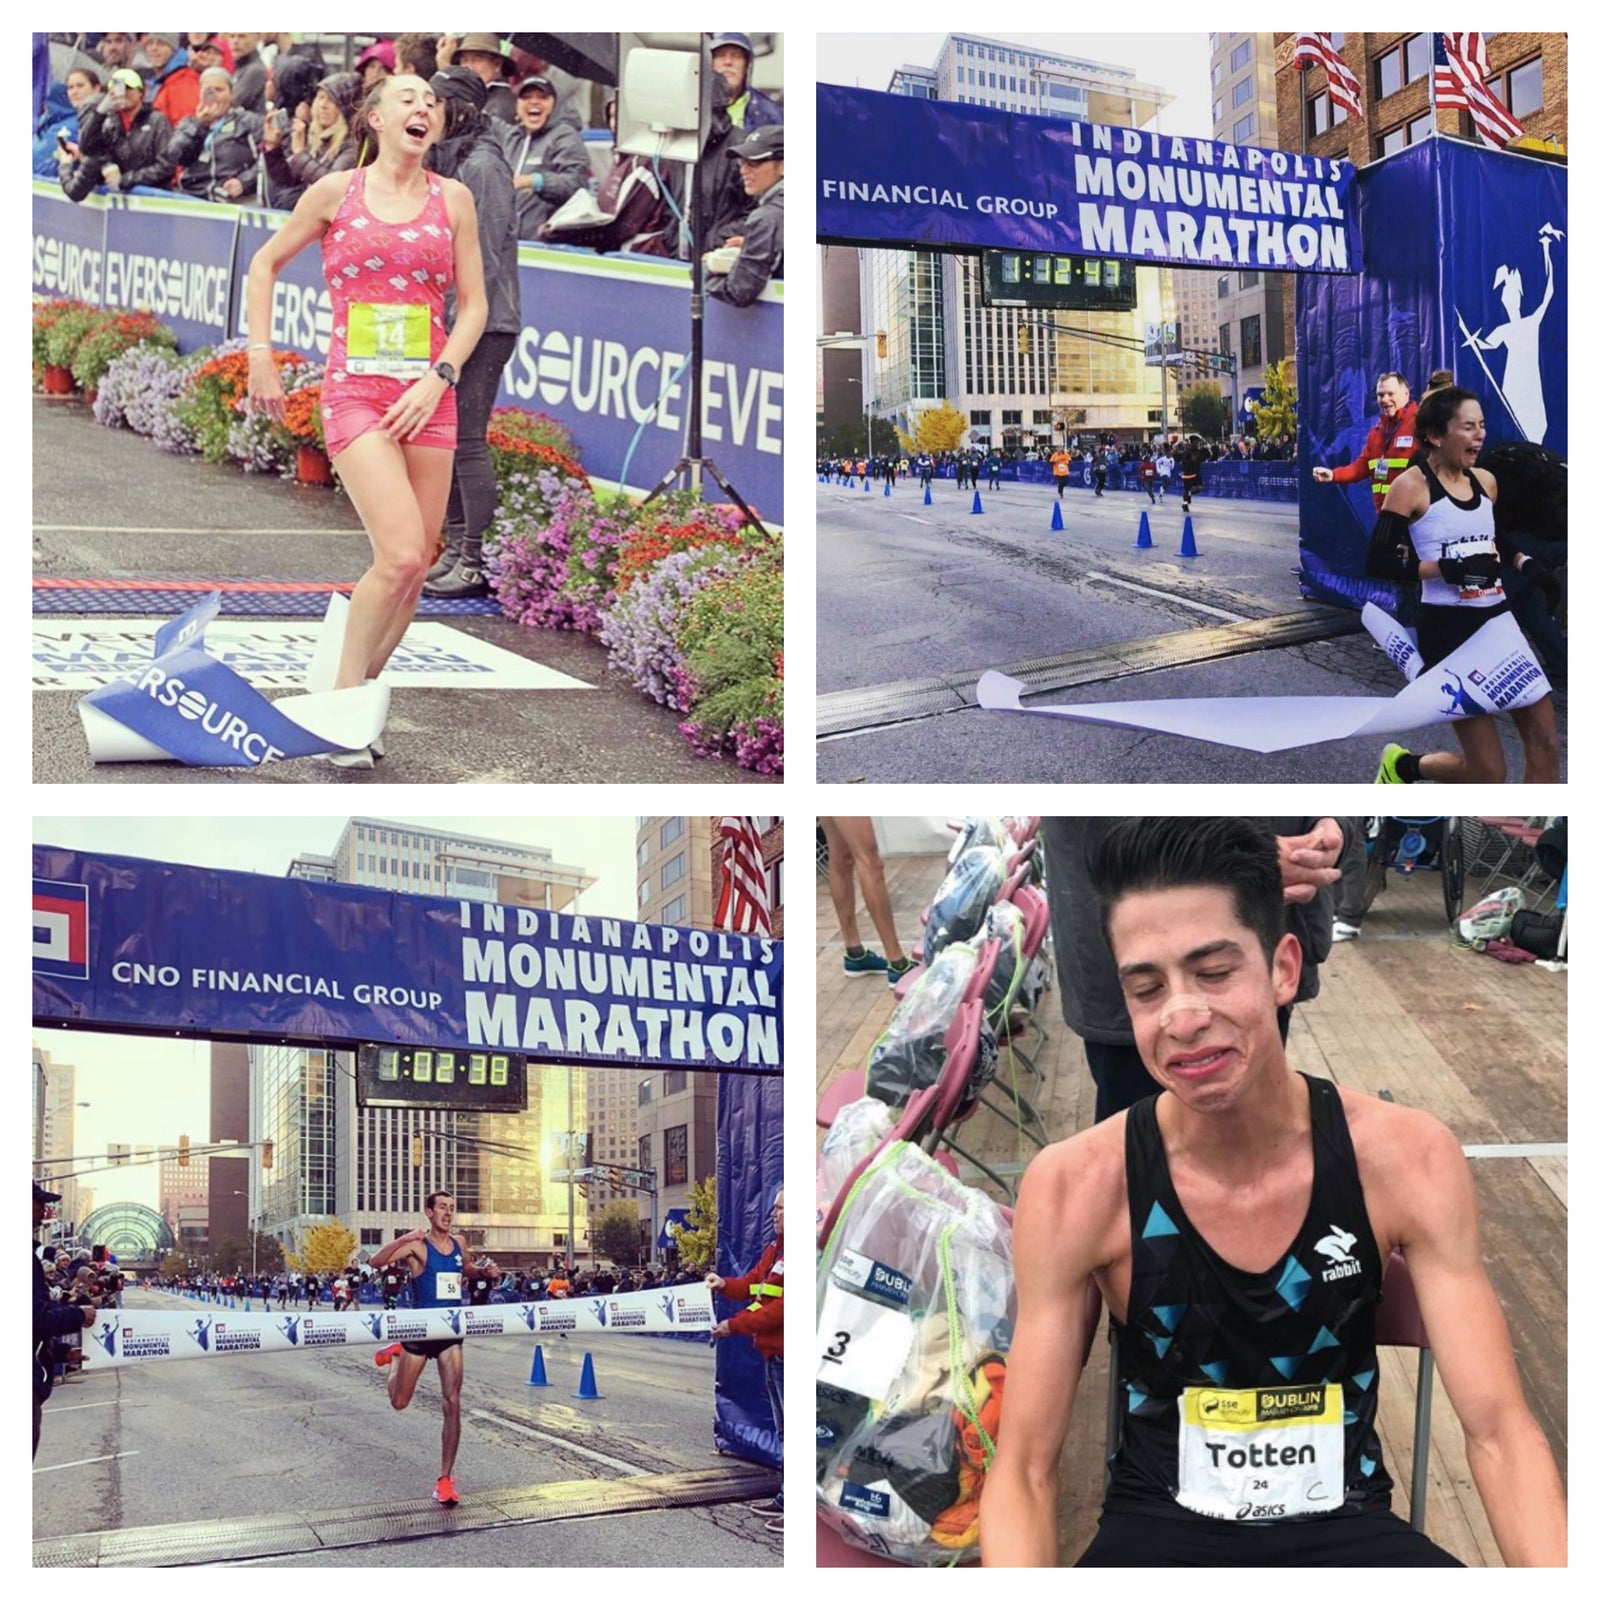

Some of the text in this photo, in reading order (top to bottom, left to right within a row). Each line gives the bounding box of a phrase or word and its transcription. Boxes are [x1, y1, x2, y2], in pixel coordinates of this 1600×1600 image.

[1072, 120, 1343, 183] INDIANAPOLIS
[823, 179, 1058, 220] FINANCIAL GROUP
[1074, 153, 1344, 220] MONUMENTAL
[1079, 202, 1349, 270] MARATHON
[106, 252, 228, 327] EVERSOURCE
[377, 321, 406, 349] 14
[1481, 654, 1526, 694] INDIANAPOLIS
[1487, 660, 1534, 701] MONUMENTAL
[1495, 667, 1542, 709] MARATHON
[459, 900, 773, 965] INDIANAPOLIS
[111, 961, 442, 1011] CNO FINANCIAL GROUP
[461, 937, 777, 1009] MONUMENTAL
[465, 990, 780, 1066] MARATHON
[447, 1283, 456, 1294] 56
[1321, 1259, 1362, 1283] rabbit
[123, 1349, 170, 1357] MARATHON
[215, 1343, 261, 1351] MARATHON
[1221, 1400, 1239, 1409] sse
[1261, 1391, 1321, 1409] DUBLIN
[1205, 1442, 1316, 1469] Totten
[1253, 1480, 1269, 1490] 24
[1252, 1503, 1286, 1518] asics
